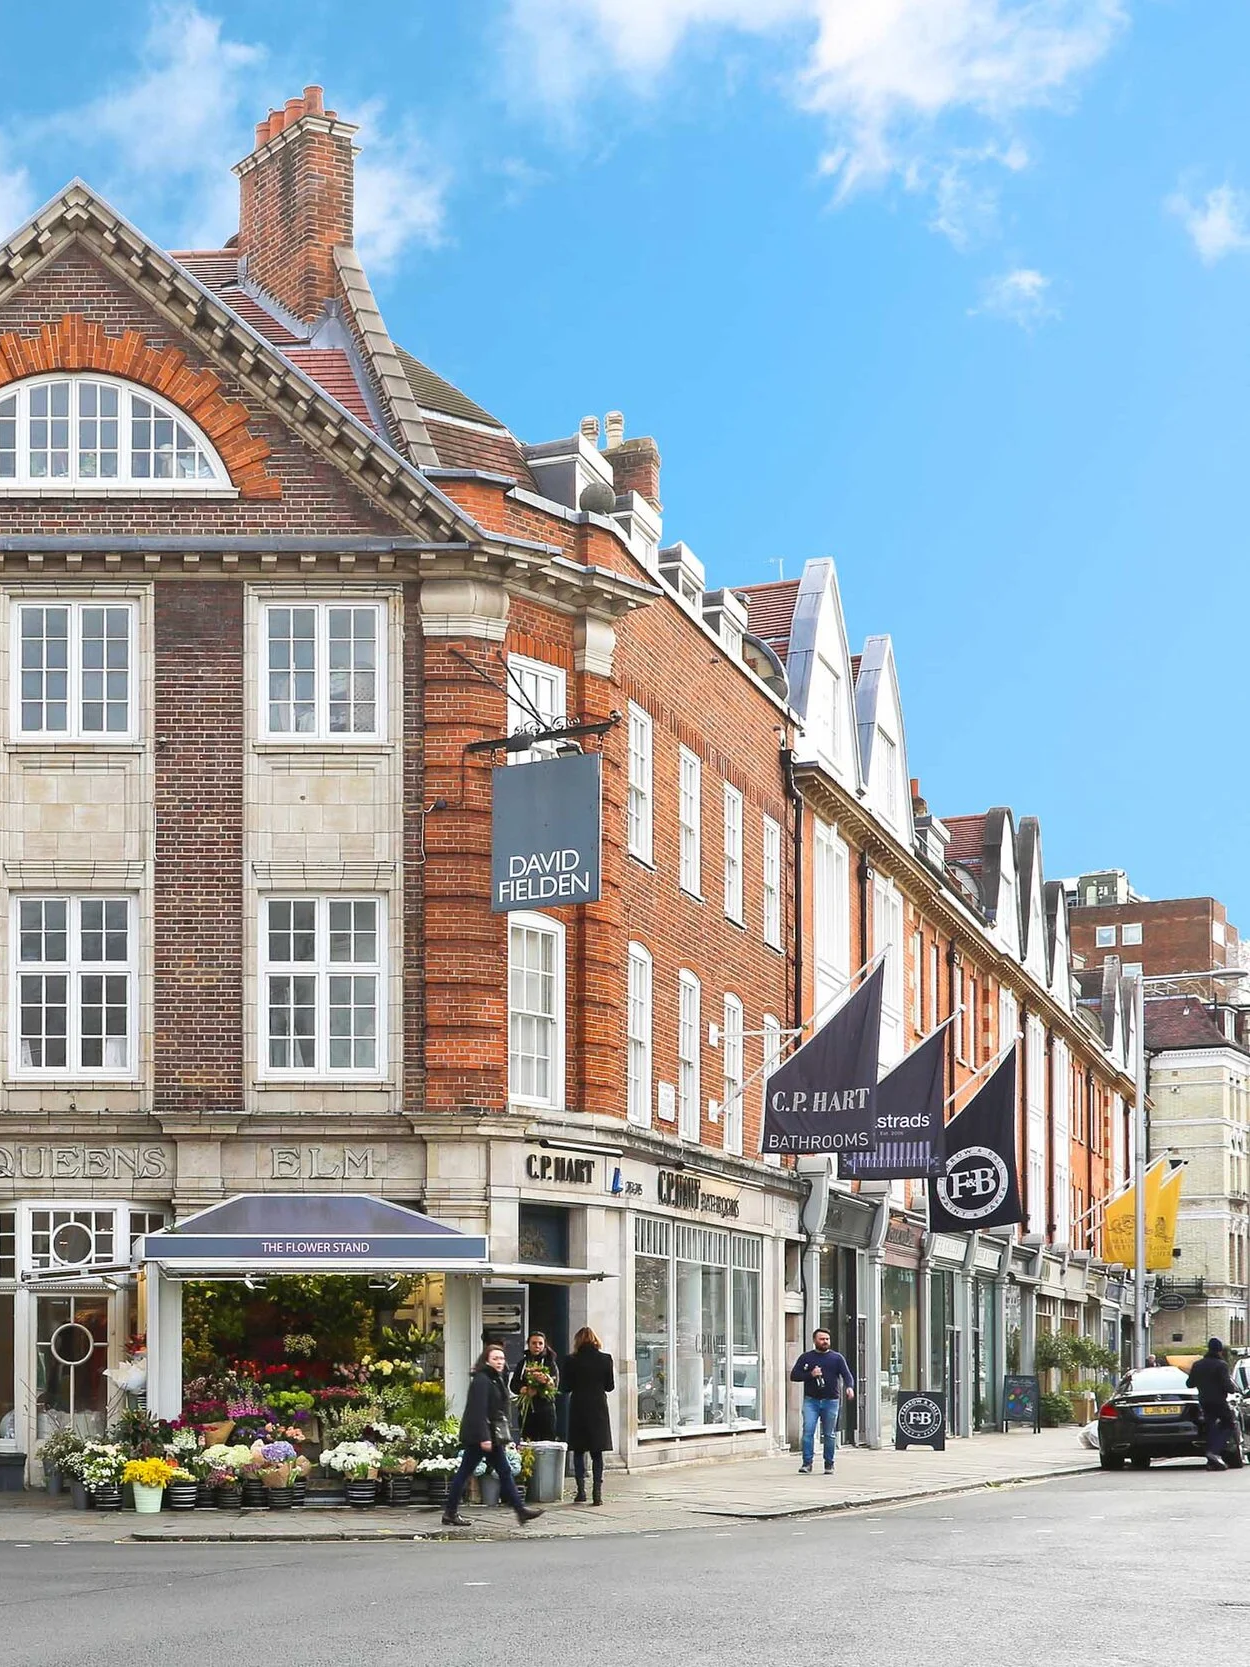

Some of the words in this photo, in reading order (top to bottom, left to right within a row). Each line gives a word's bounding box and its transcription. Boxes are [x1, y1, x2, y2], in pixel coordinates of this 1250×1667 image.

[509, 849, 580, 878] DAVID
[498, 871, 590, 903] FIELDEN
[772, 1091, 807, 1112] C.P.
[812, 1088, 870, 1112] HART
[875, 1113, 930, 1129] strads
[769, 1132, 869, 1149] BATHROOMS
[271, 1147, 374, 1180] ELM
[526, 1154, 552, 1181] C.P.
[554, 1157, 595, 1184] HART
[950, 1167, 997, 1199] F&B
[261, 1242, 283, 1253] THE
[286, 1242, 330, 1253] FLOWER
[333, 1242, 370, 1253] STAND
[908, 1411, 932, 1425] F&B
